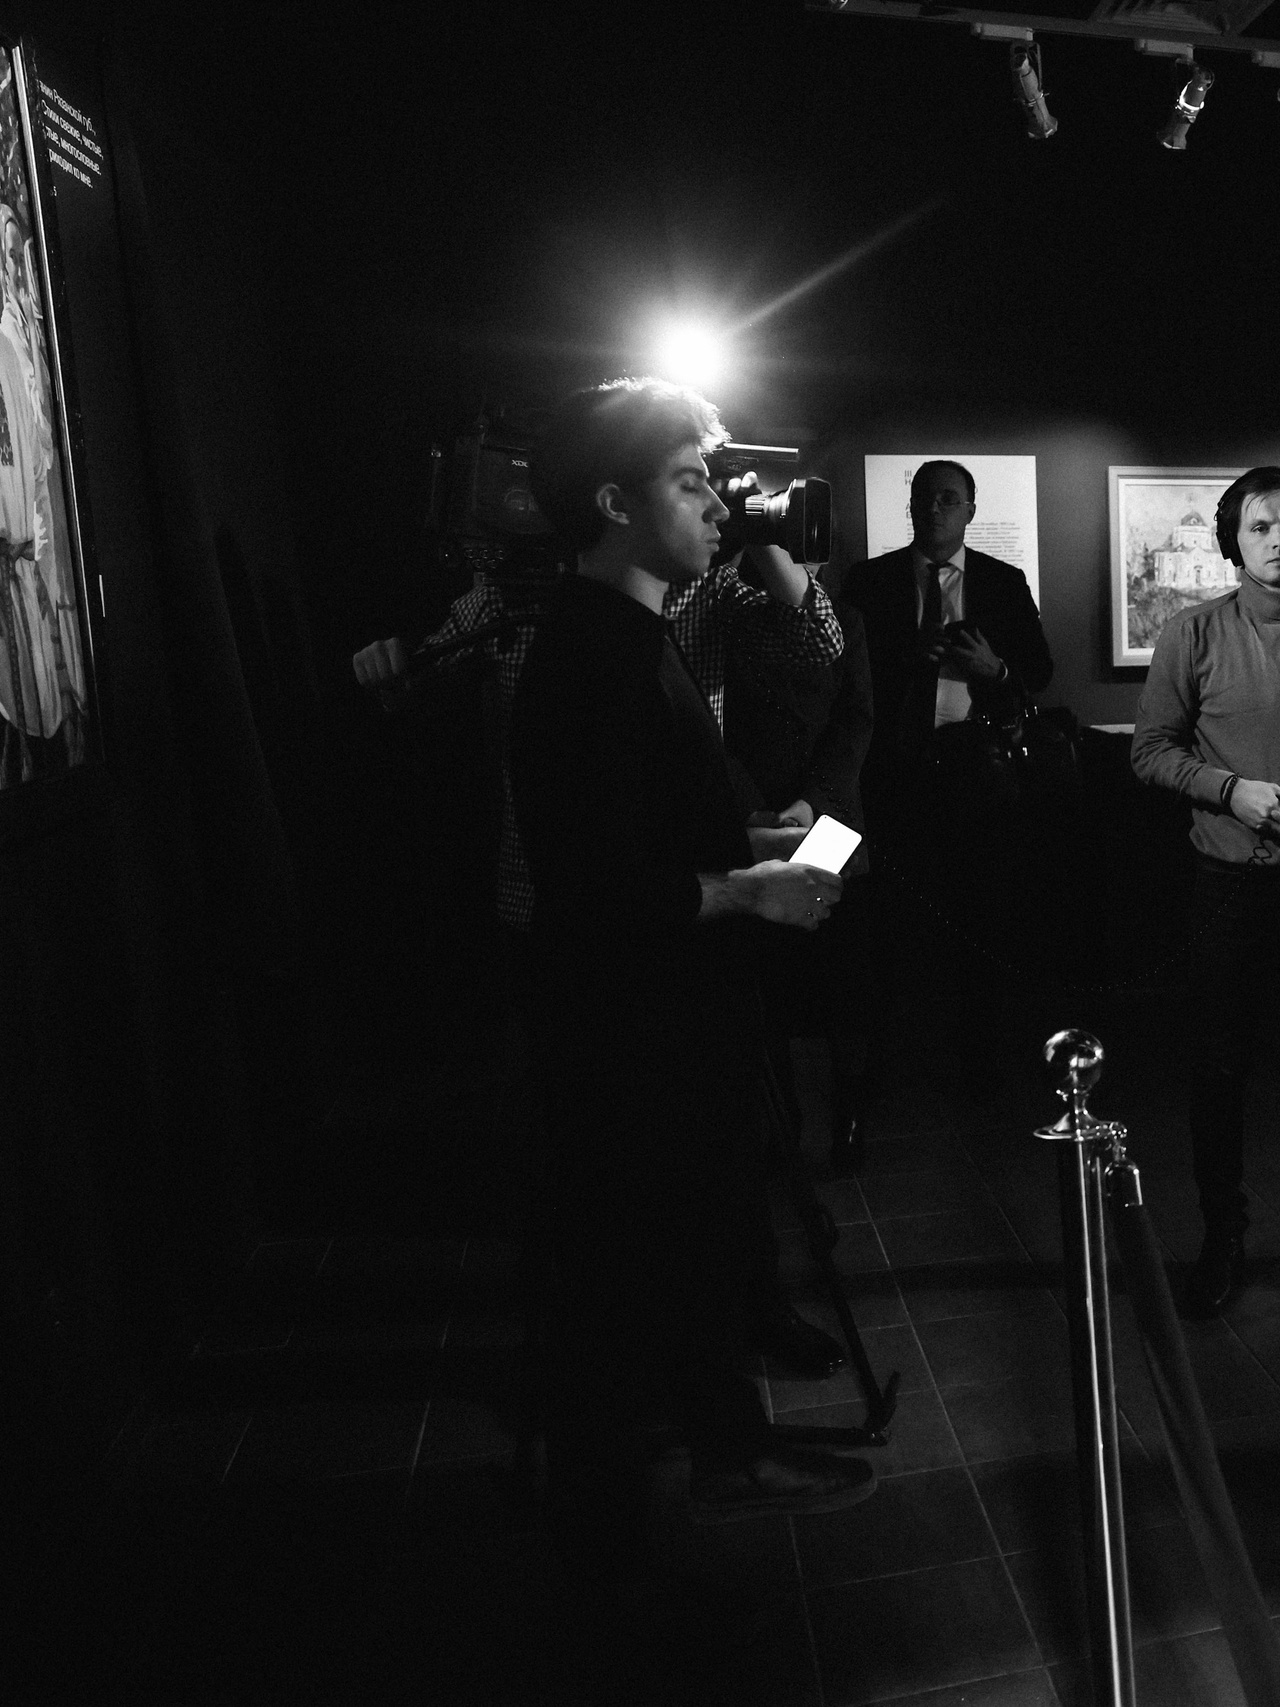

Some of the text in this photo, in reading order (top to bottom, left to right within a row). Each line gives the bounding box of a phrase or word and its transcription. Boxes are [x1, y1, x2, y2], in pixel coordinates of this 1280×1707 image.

[53, 89, 82, 124] Рязанской
[60, 117, 82, 145] свежие,
[82, 134, 103, 160] чистые,
[60, 137, 101, 175] многословные.
[48, 148, 73, 173] риходил
[80, 170, 93, 188] мне.
